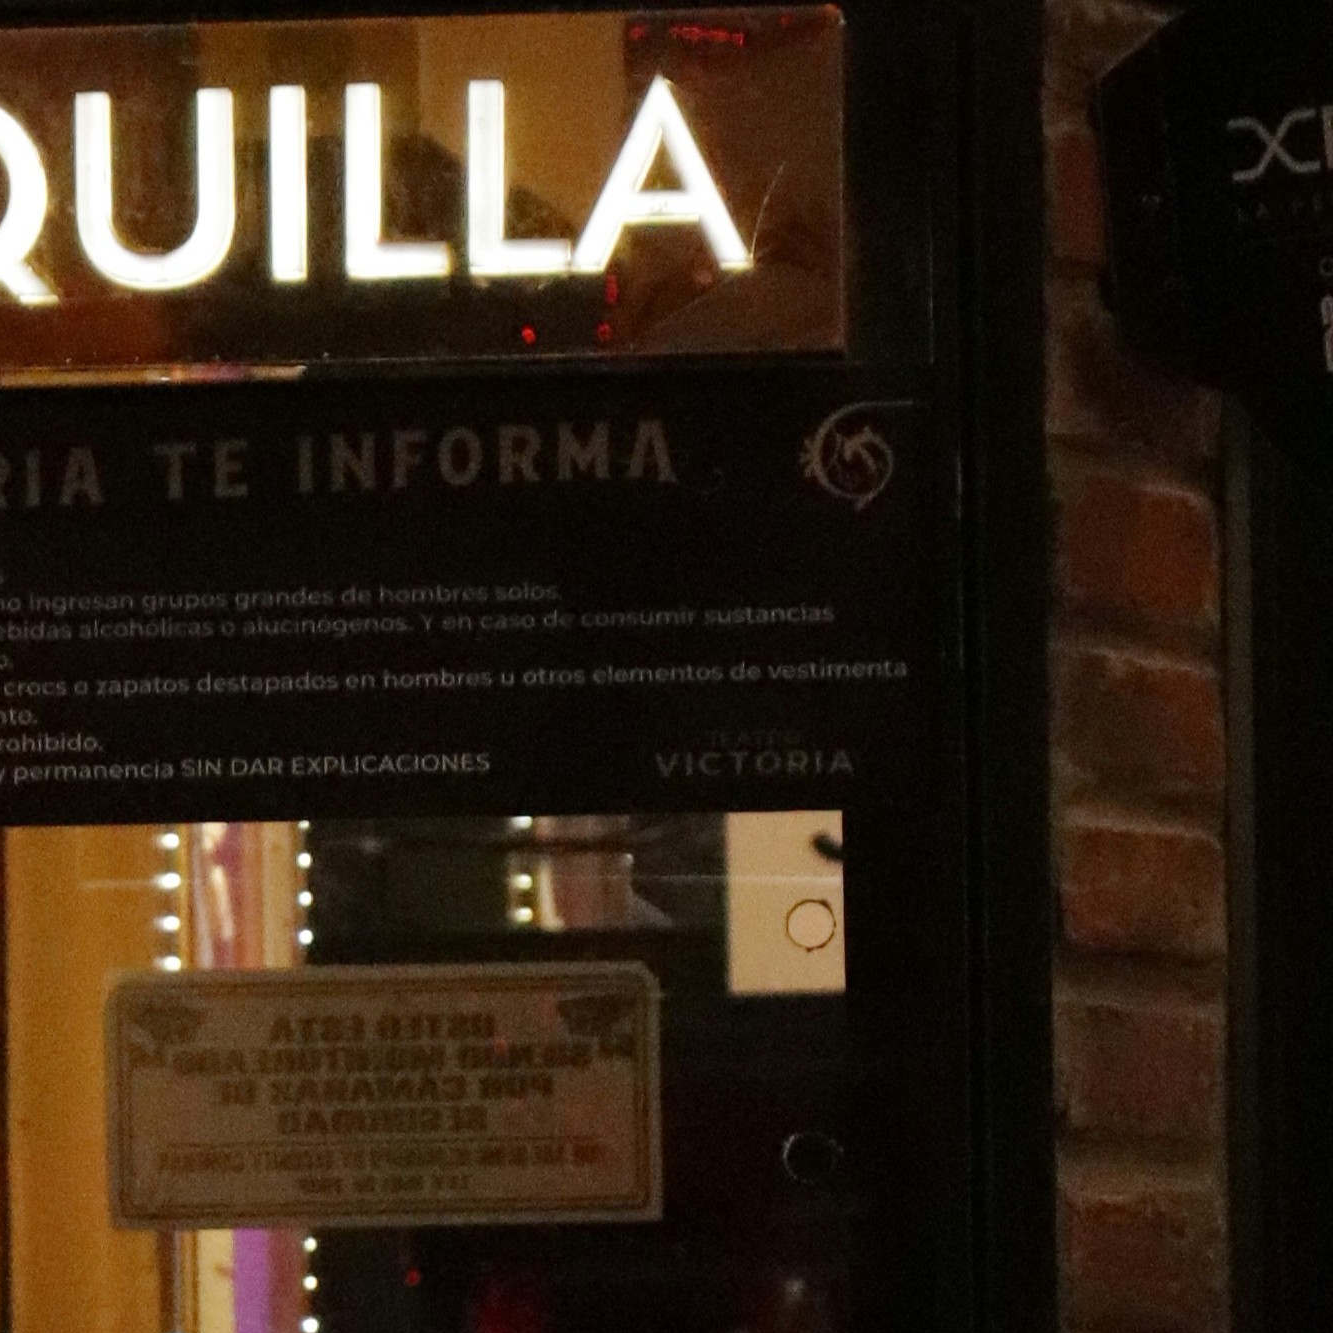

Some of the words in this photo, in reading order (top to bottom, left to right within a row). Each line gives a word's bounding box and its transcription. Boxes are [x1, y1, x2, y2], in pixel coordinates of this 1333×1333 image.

[153, 438, 250, 501] TE
[295, 417, 679, 496] INFORMA
[27, 590, 136, 617] ingresan
[140, 592, 229, 614] grupos
[233, 586, 335, 612] grandes
[340, 585, 372, 605] de
[377, 583, 489, 604] hombres
[219, 620, 236, 636] o
[441, 615, 474, 631] en
[478, 614, 537, 630] caso
[541, 609, 573, 629] de
[580, 607, 695, 628] consumir
[703, 604, 835, 625] sustancias
[2, 680, 69, 696] crocs
[72, 679, 90, 695] o
[94, 673, 191, 699] zapatos
[194, 670, 340, 697] destapados
[343, 673, 377, 689] en
[381, 667, 494, 688] hombres
[498, 670, 516, 686] u
[521, 665, 586, 685] otros
[590, 662, 724, 684] elementos
[728, 661, 762, 681] de
[767, 658, 908, 680] vestimenta
[11, 758, 175, 785] permanencia
[179, 757, 224, 777] SIN
[228, 755, 285, 775] DAR
[289, 751, 492, 774] EXPLICACIONES
[655, 749, 855, 778] VICTORIA
